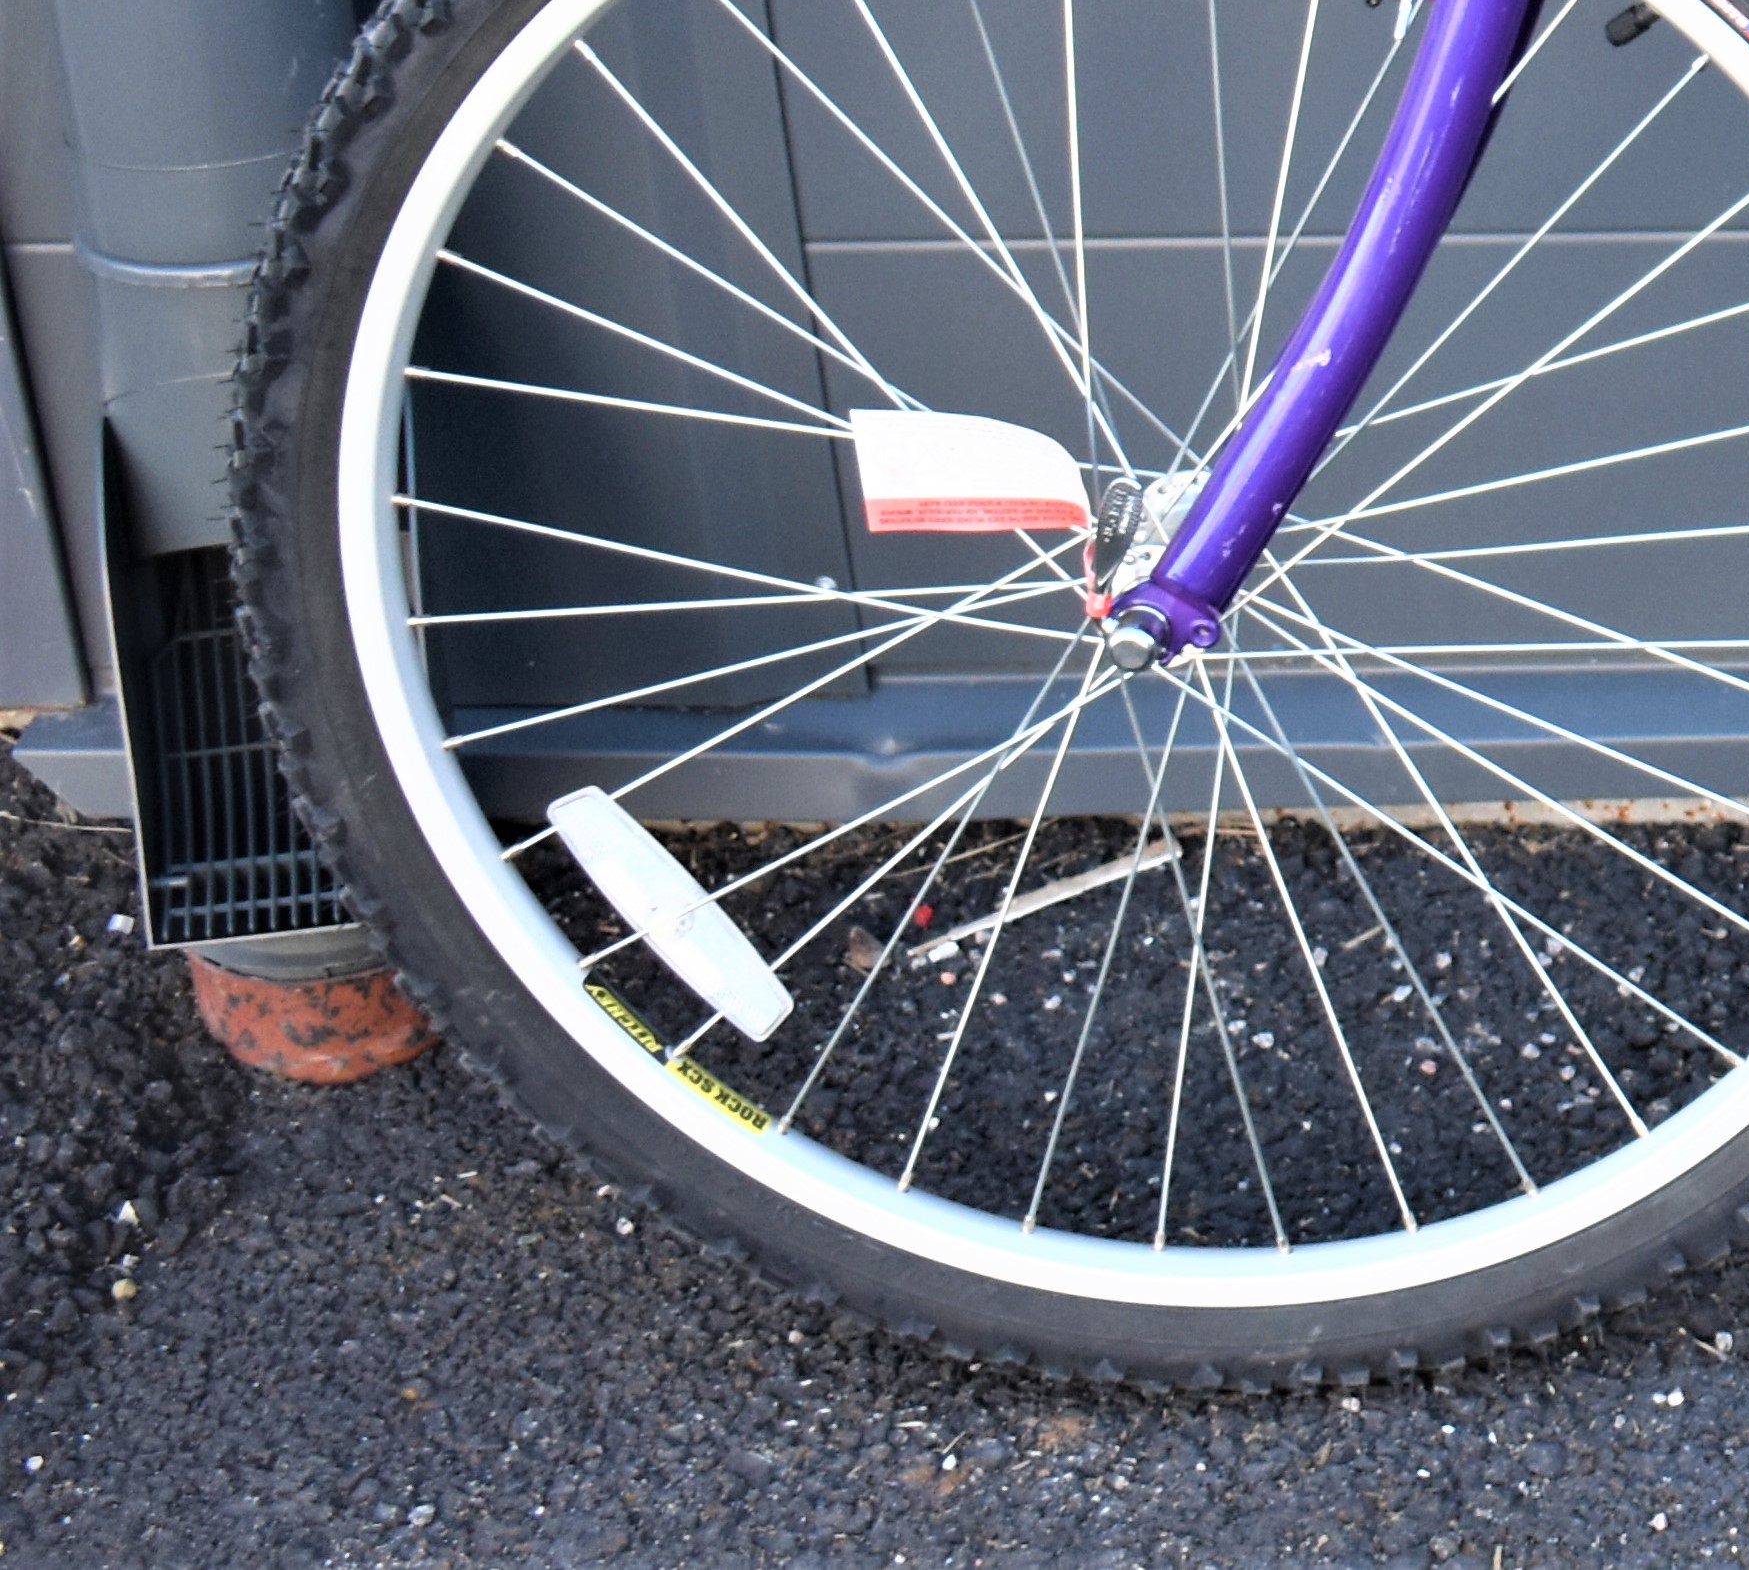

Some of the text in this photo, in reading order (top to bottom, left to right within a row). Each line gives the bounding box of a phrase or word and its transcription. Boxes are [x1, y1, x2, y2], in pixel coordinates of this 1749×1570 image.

[584, 984, 665, 1053] RITCHEY
[676, 1060, 768, 1130] ROCK SCX
